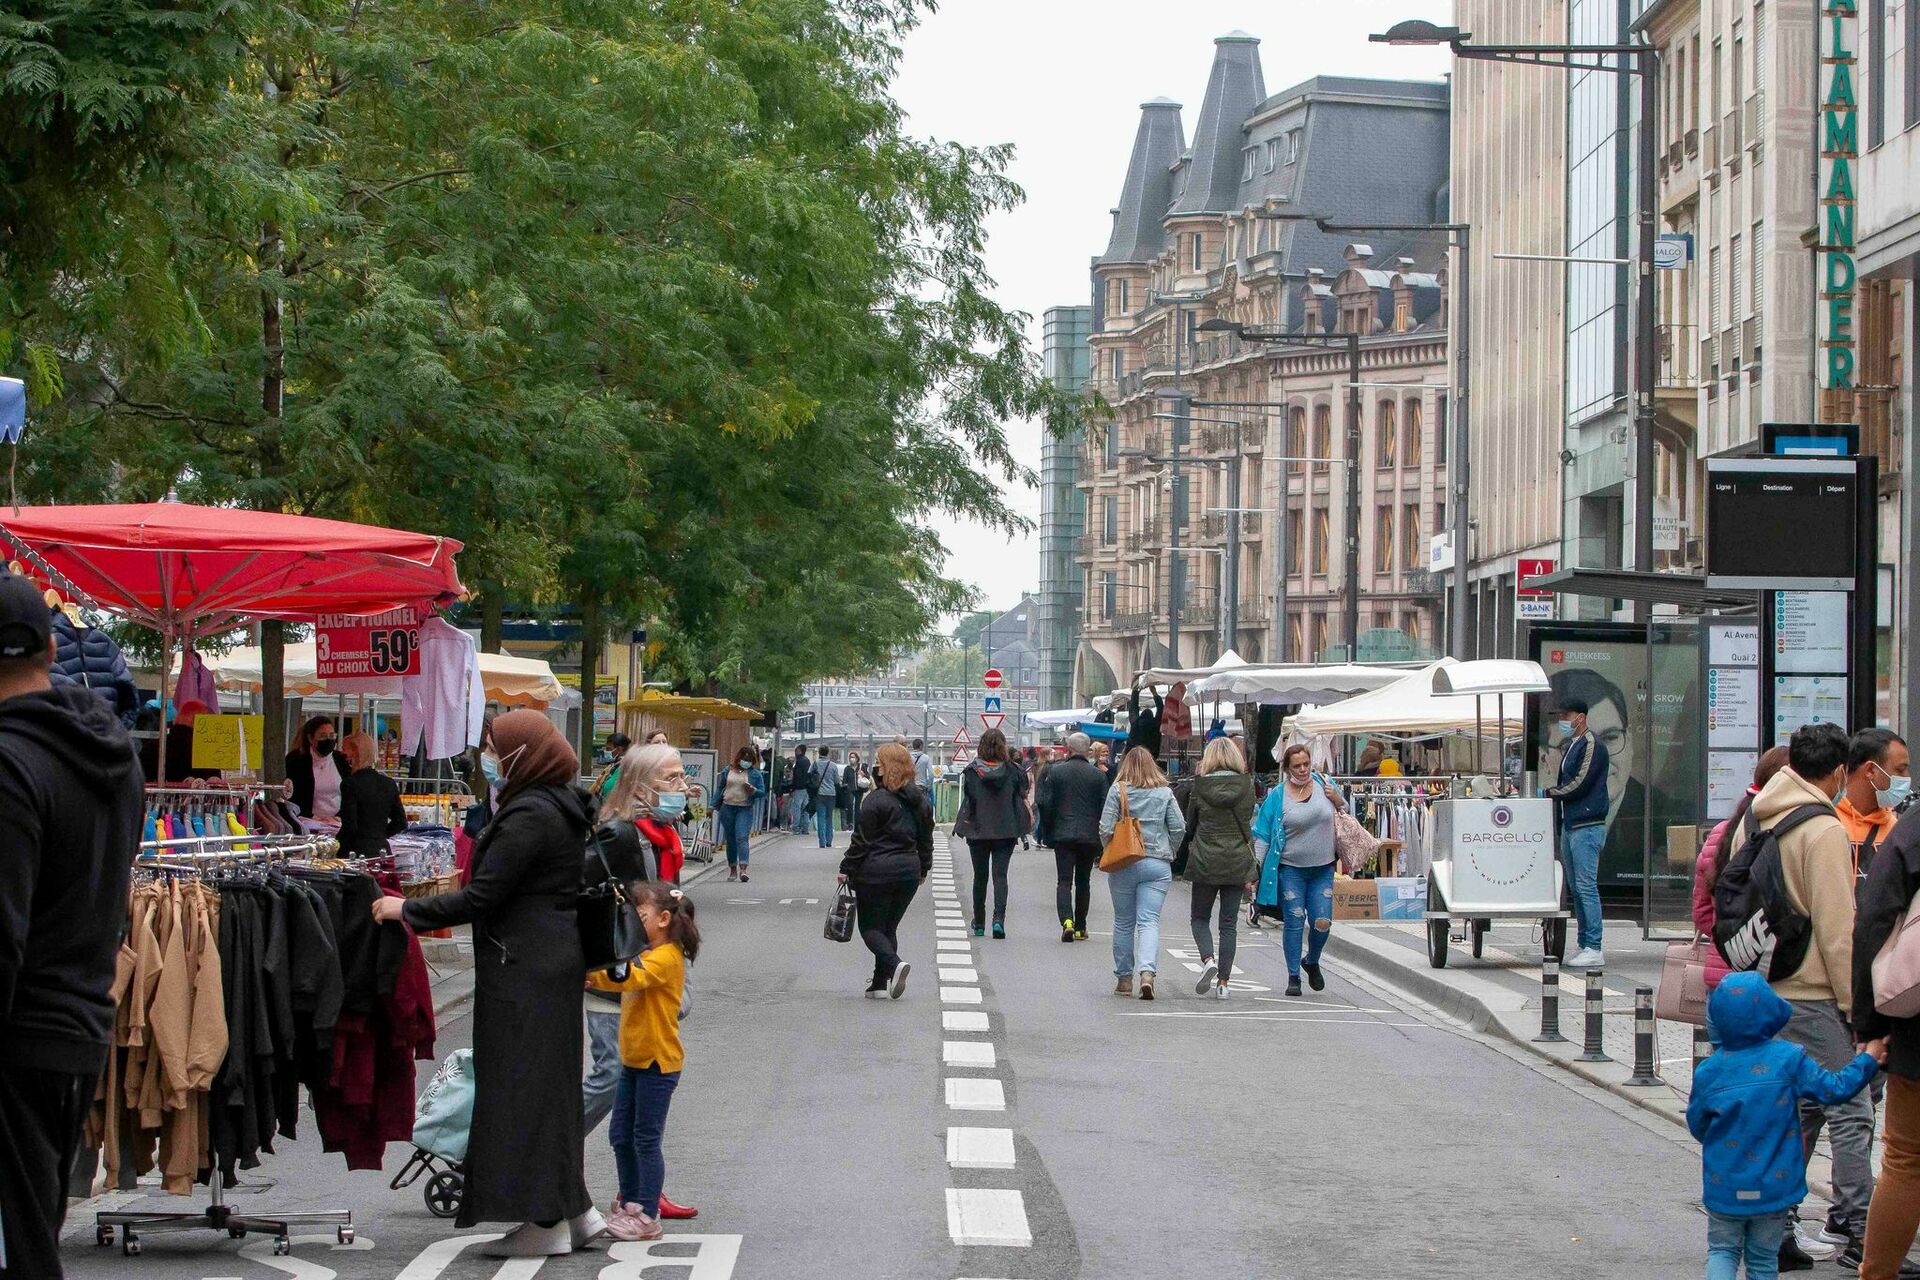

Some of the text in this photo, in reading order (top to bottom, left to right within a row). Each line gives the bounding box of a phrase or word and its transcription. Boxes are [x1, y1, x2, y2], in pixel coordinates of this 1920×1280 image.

[1826, 0, 1857, 389] LAMANDER
[1827, 485, 1845, 493] Départ
[1520, 604, 1550, 612] S-BANK
[317, 608, 417, 629] EXCEPTIONNEL
[317, 633, 369, 661] 3 CHEMISES
[1731, 653, 1757, 662] Quai 2
[319, 660, 370, 674] AU CHOIX
[1636, 693, 1685, 703] W GROW
[1724, 907, 1777, 972] NIKE
